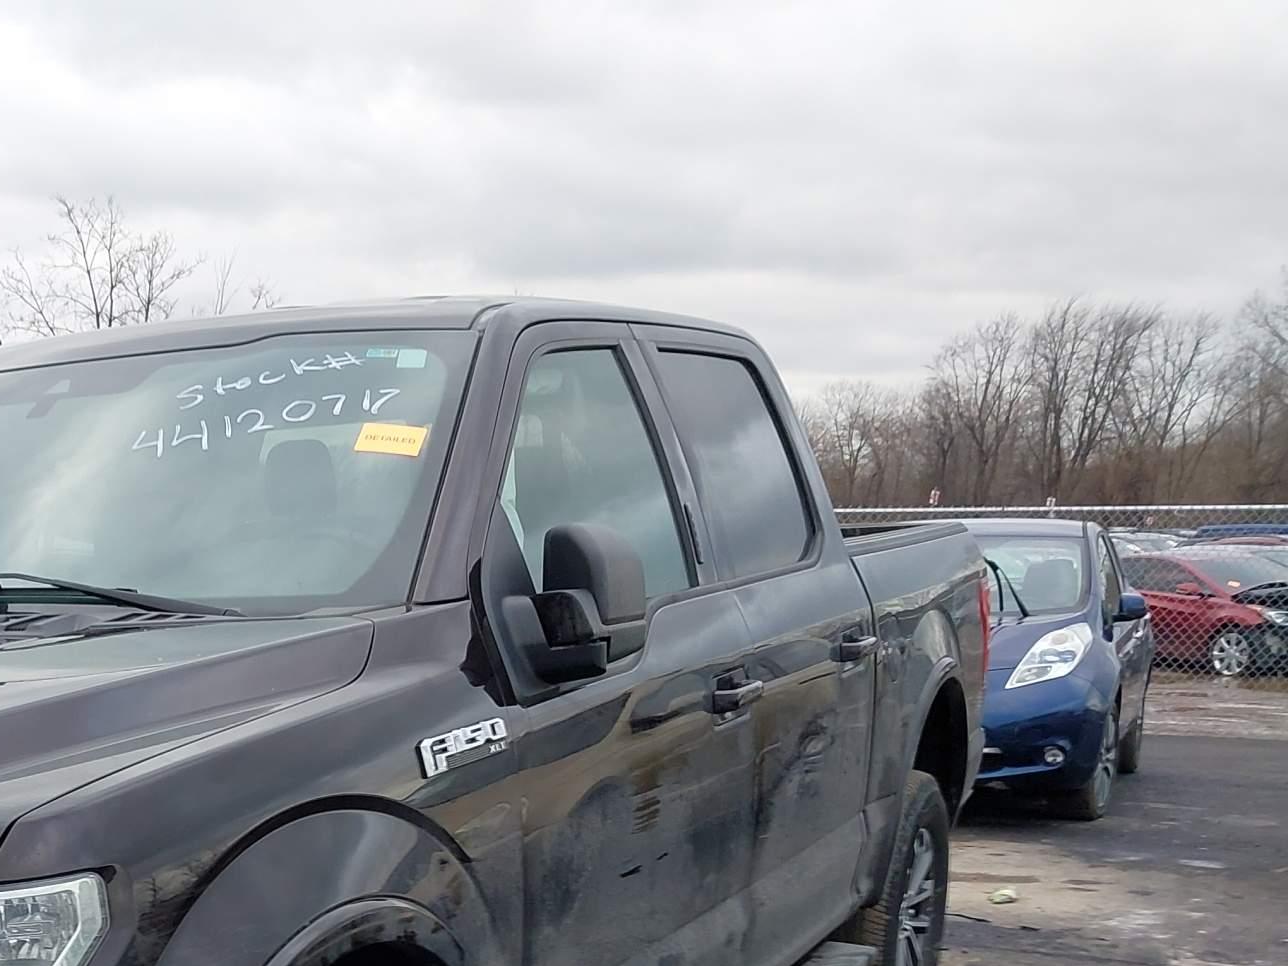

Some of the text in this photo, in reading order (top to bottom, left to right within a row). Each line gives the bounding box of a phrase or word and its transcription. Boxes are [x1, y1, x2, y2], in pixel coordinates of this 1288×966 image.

[132, 389, 401, 457] 44120717
[364, 434, 417, 446] DETAILED
[488, 741, 508, 754] XLT
